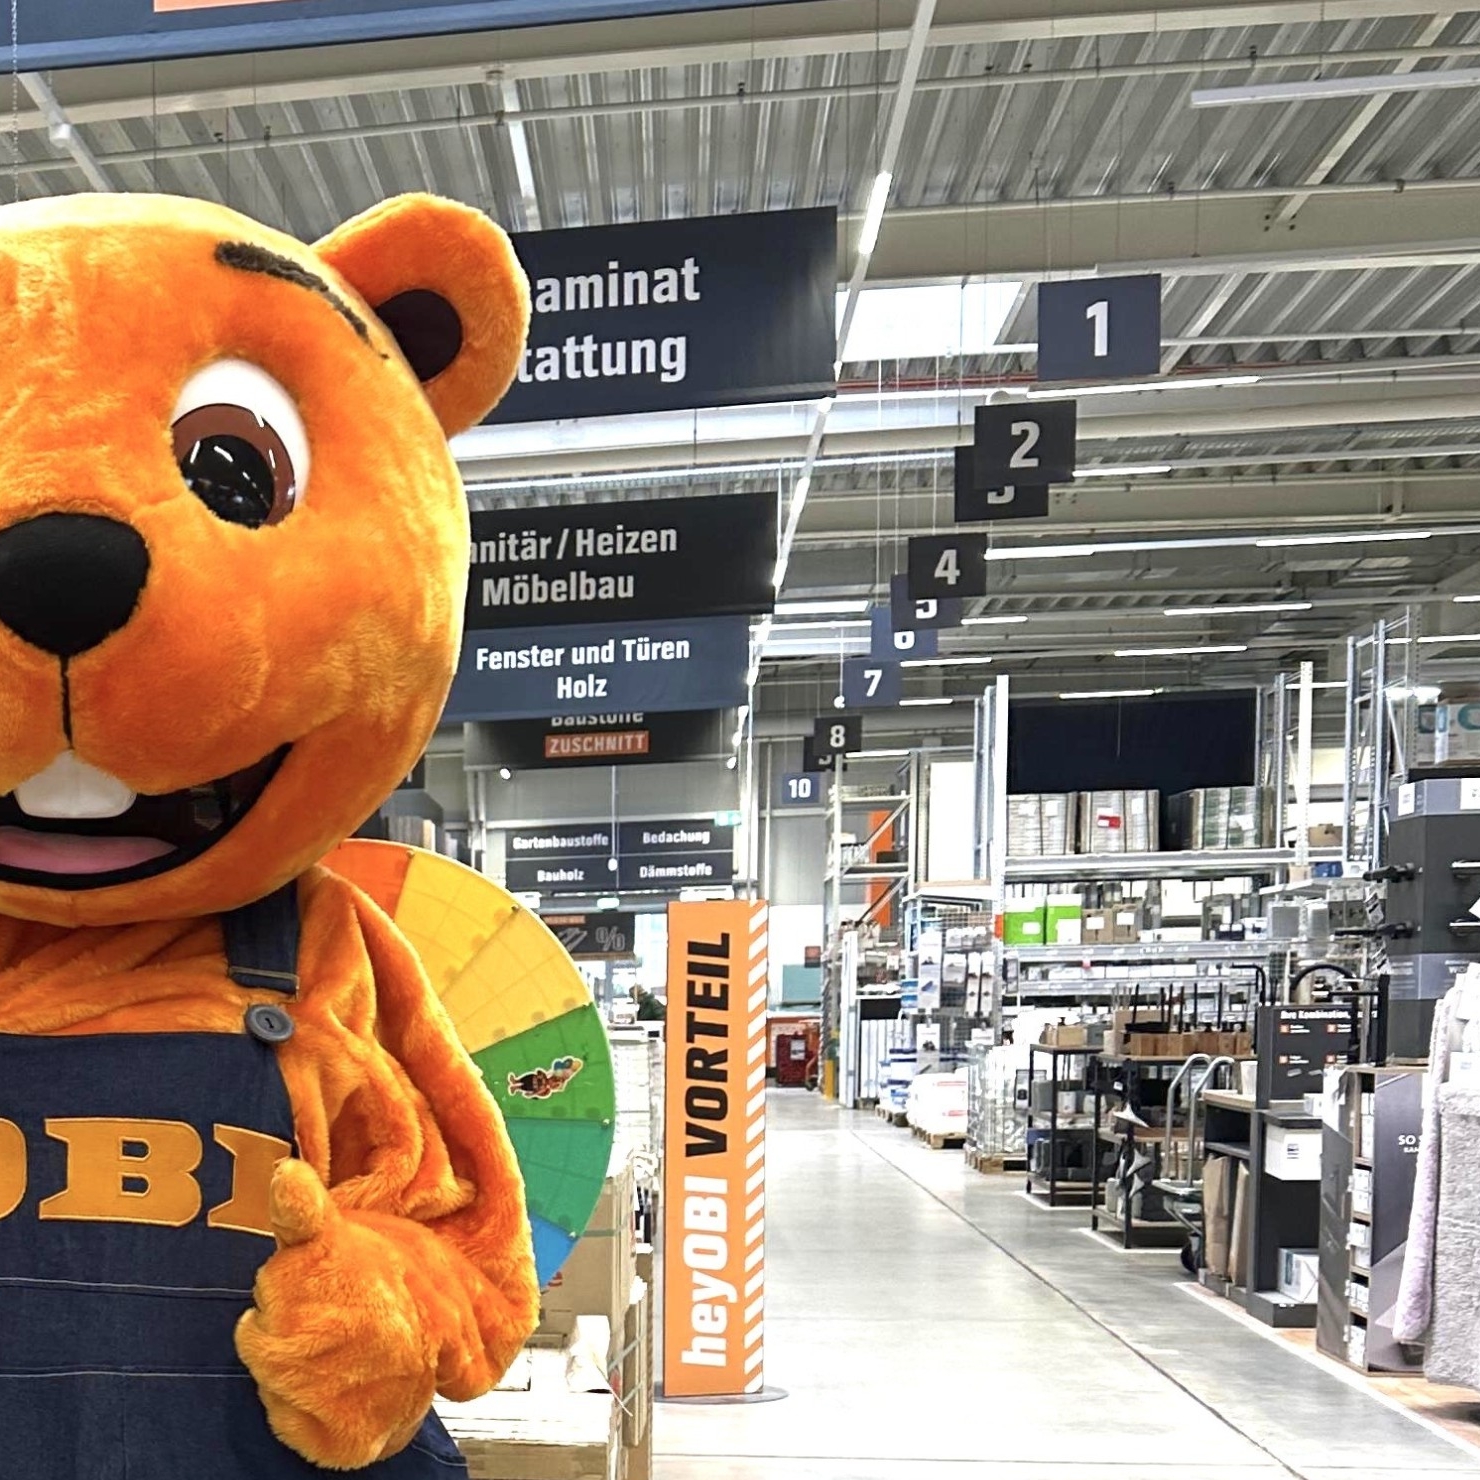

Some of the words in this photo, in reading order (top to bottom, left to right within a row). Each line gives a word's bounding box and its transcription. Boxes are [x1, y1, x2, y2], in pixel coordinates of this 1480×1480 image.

[534, 257, 700, 313] aminat
[1086, 301, 1109, 356] 1
[518, 334, 686, 382] tattung
[1010, 421, 1040, 468] 2
[576, 524, 677, 557] Heizen
[934, 549, 960, 585] 4
[482, 570, 634, 607] Möbelbau
[476, 645, 565, 670] Fenster
[572, 639, 614, 665] und
[622, 637, 690, 662] Türen
[556, 674, 608, 699] Holz
[863, 670, 882, 697] 7
[549, 734, 646, 754] ZUSCHNITT
[829, 724, 846, 748] 8
[788, 778, 812, 798] 10
[513, 834, 609, 850] Gartenbaustoffe
[642, 829, 711, 847] Bedachung
[536, 868, 584, 882] Bauholz
[639, 863, 713, 879] Dämmstoffe
[685, 932, 730, 1158] VORTEIL
[681, 1175, 738, 1367] heyOBI
